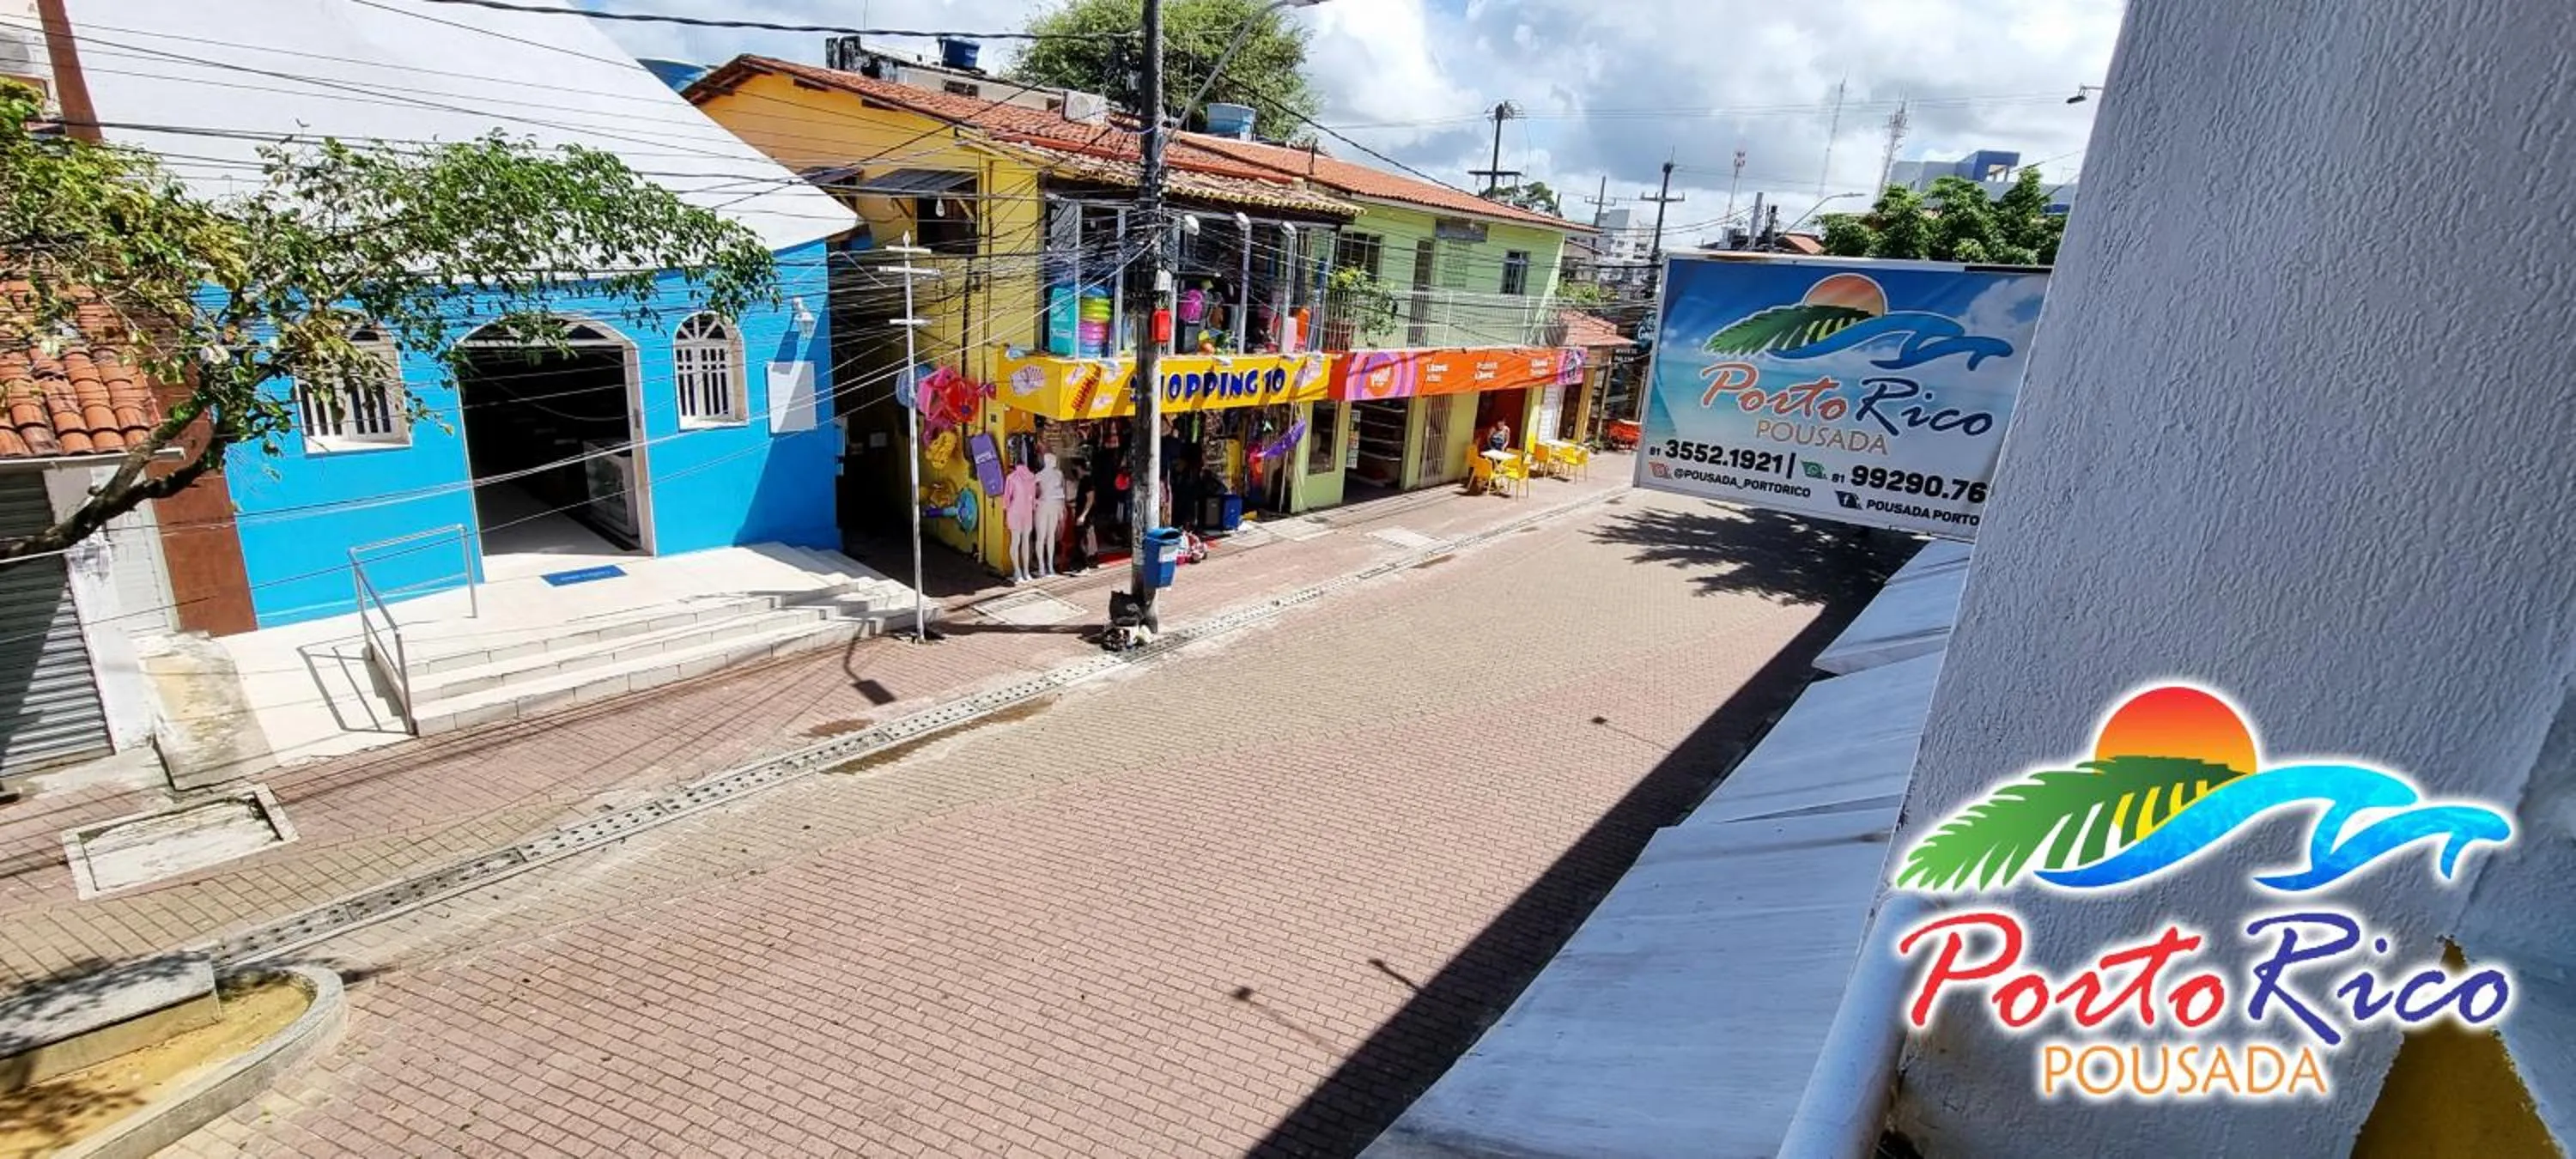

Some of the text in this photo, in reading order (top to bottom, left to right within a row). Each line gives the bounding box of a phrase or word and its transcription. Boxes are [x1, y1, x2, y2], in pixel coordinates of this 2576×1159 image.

[1264, 367, 1286, 394] 10
[1701, 361, 1993, 436] Porto Rico
[1756, 420, 1889, 456] POUSADA
[1665, 439, 1783, 474] 3552.1921
[1831, 473, 1845, 483] 81
[1850, 464, 1989, 503] 99290.76
[1674, 468, 1812, 498] @POUSADA_PORTORICO
[1866, 499, 1981, 526] POUSADA PORTO
